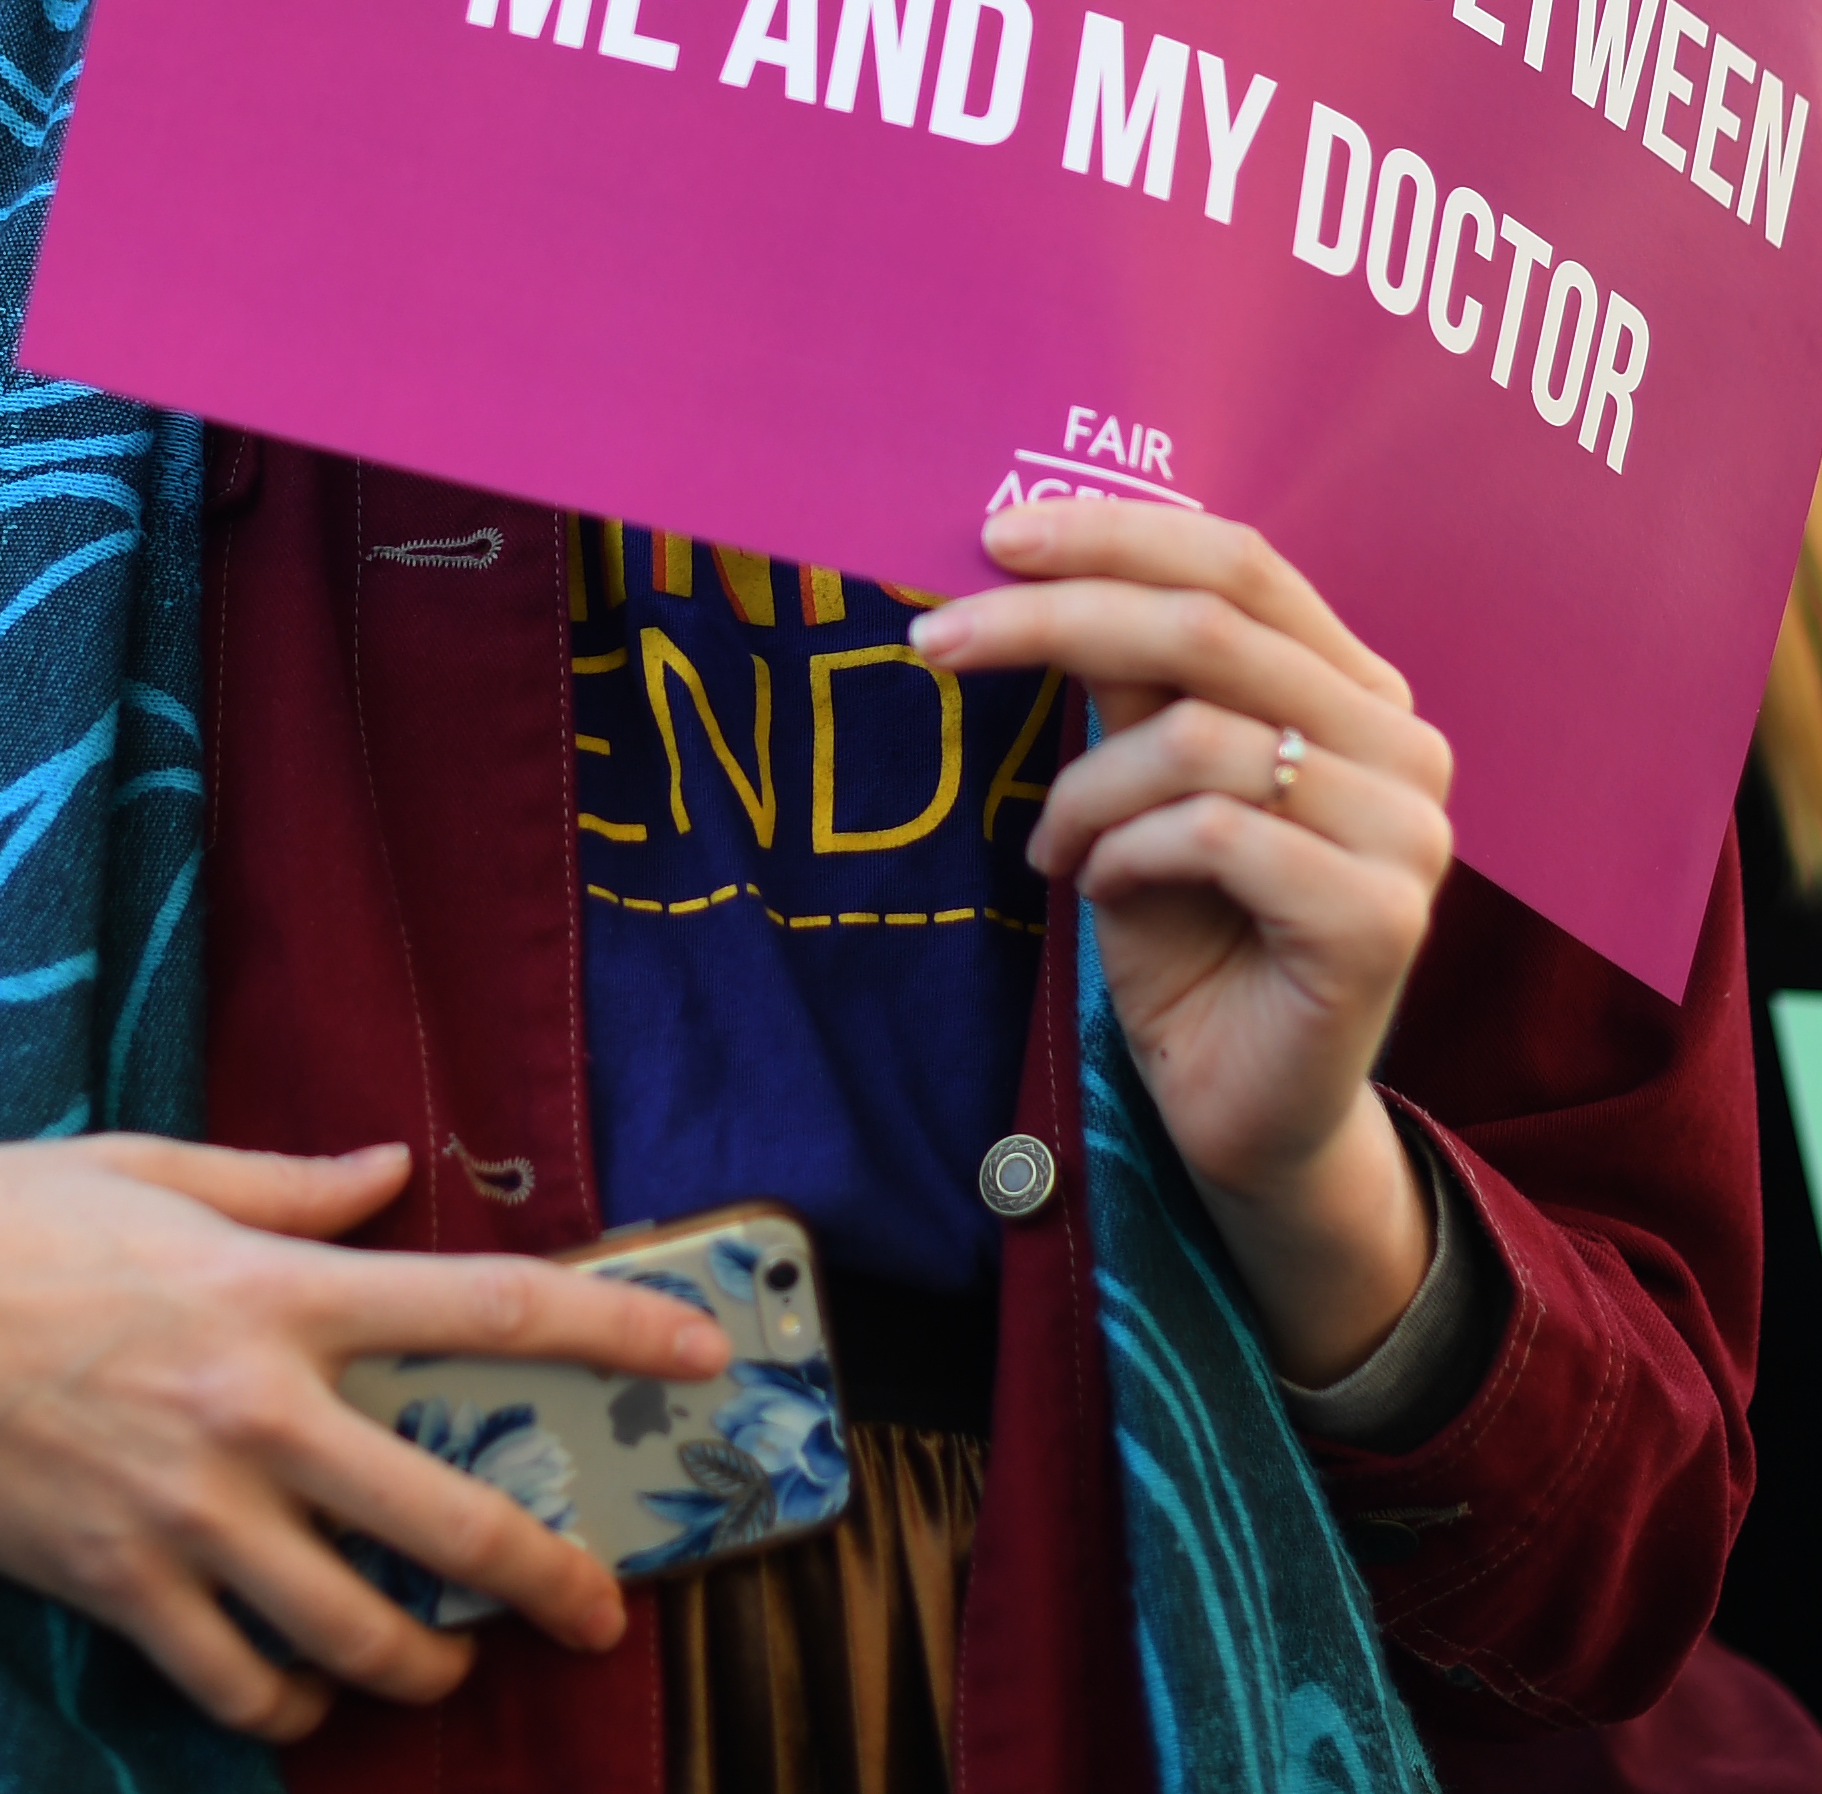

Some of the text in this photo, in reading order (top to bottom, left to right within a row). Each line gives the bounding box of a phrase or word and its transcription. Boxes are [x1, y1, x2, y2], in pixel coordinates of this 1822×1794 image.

[1062, 11, 1278, 225] MY
[1293, 101, 1649, 475] DOCTOR
[1063, 405, 1175, 481] FAIR
